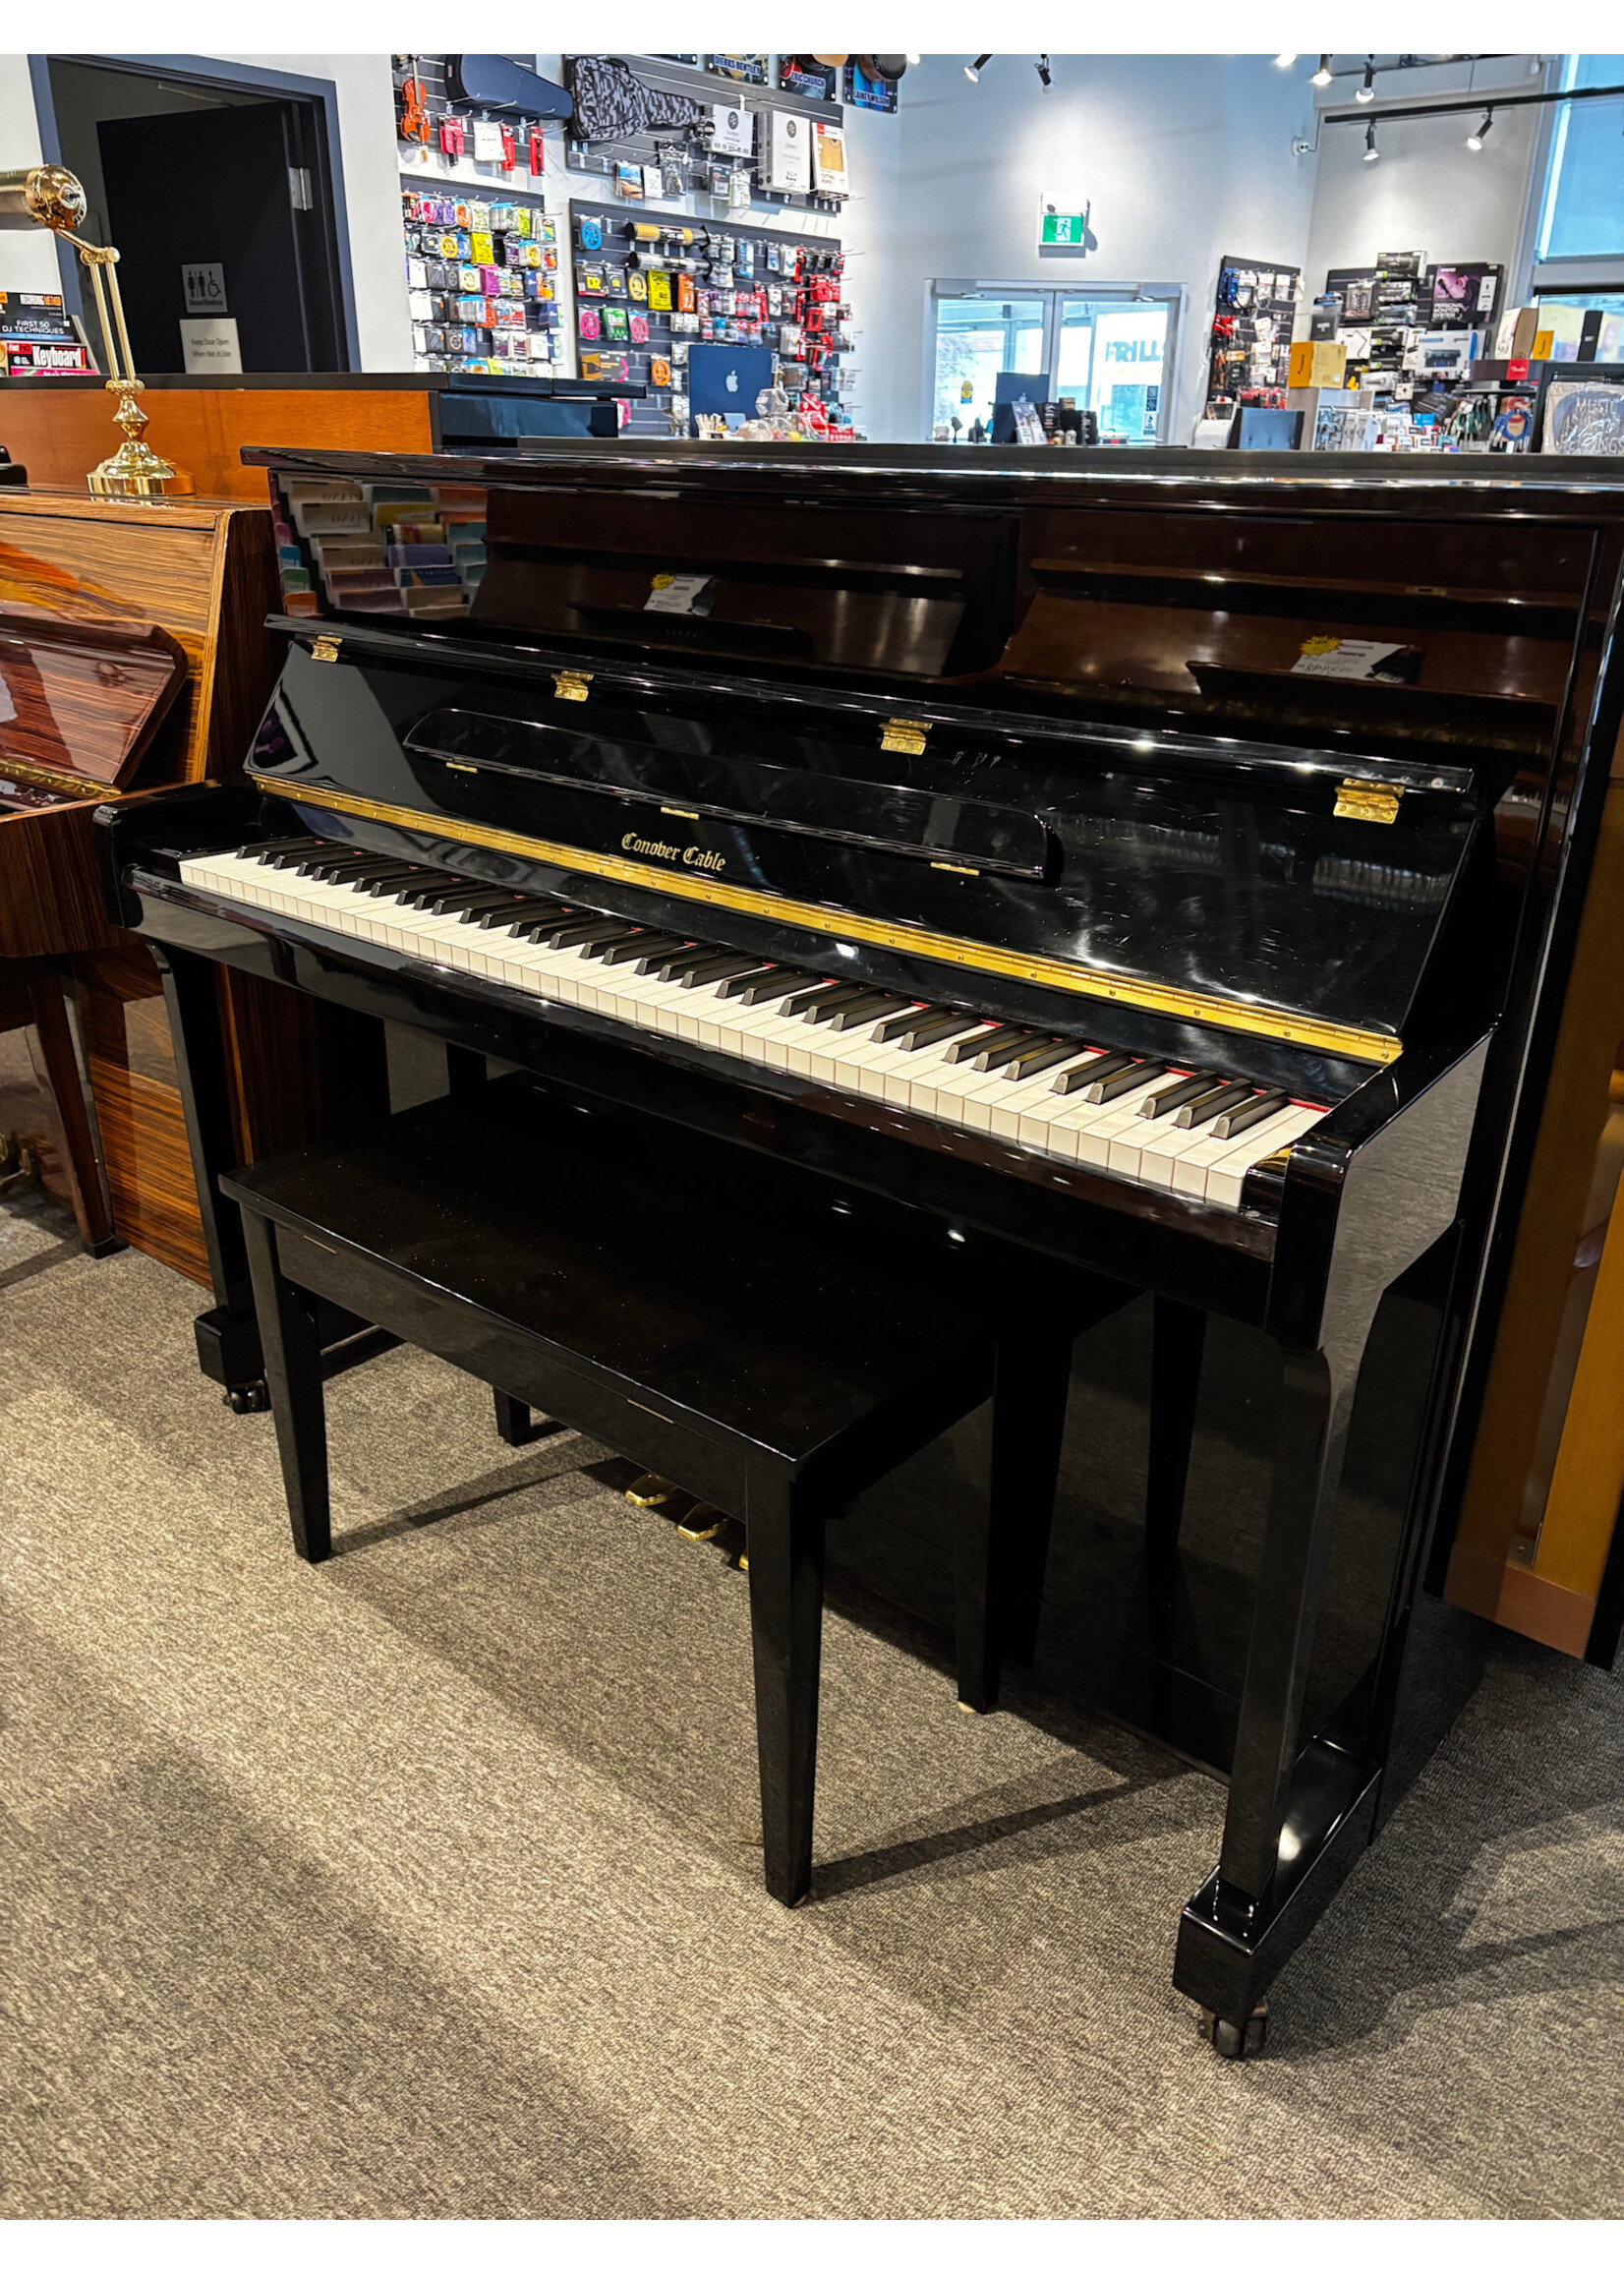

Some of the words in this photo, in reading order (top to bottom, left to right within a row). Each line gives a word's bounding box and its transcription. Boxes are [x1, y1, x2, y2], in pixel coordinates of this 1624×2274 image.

[735, 61, 761, 76] BENTLEY
[790, 71, 803, 83] ERIC
[803, 75, 826, 87] CHURCH
[32, 345, 83, 369] Keyboard
[1105, 340, 1164, 363] FRILL
[1576, 397, 1615, 415] MUSIC
[621, 832, 681, 861] Conover
[682, 846, 726, 871] Cable
